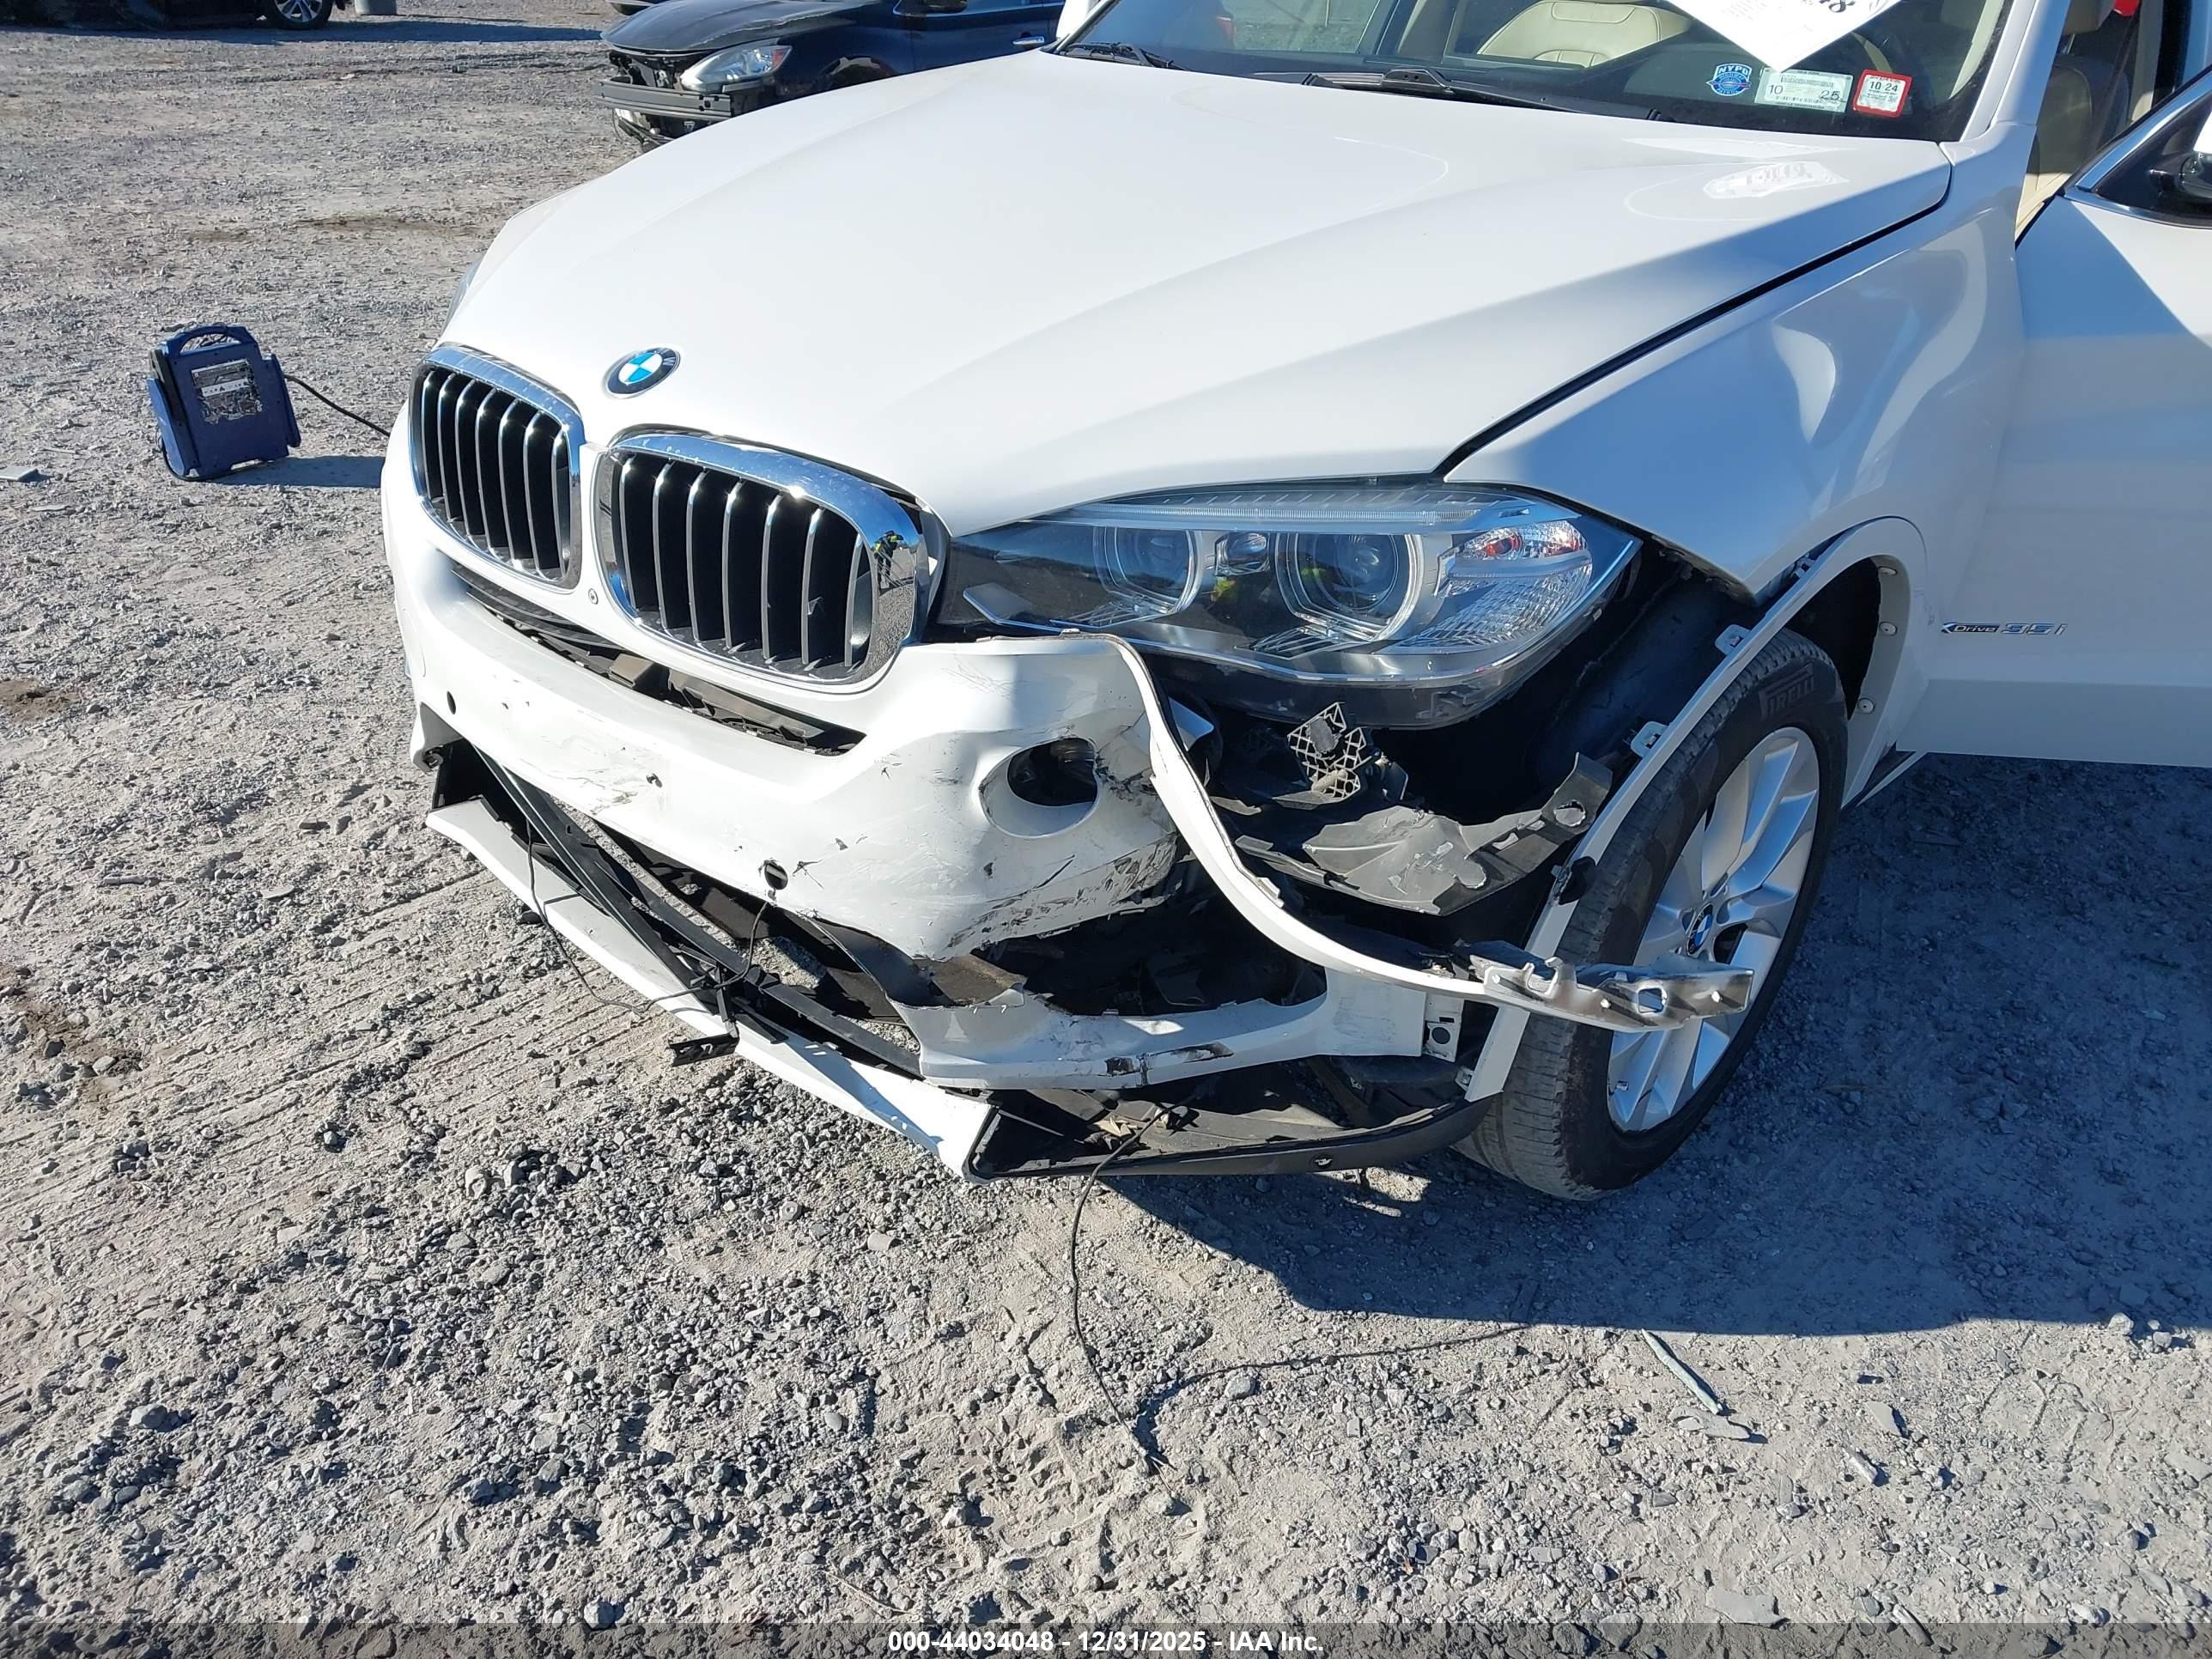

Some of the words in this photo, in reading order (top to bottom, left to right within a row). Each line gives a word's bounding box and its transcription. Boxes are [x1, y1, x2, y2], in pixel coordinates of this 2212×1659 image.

[1718, 65, 1748, 76] NYPD
[1769, 84, 1784, 95] 10
[1870, 81, 1881, 90] 10
[1884, 82, 1899, 92] 24
[2001, 623, 2068, 635] 35i
[1758, 662, 1814, 719] PIRELLI
